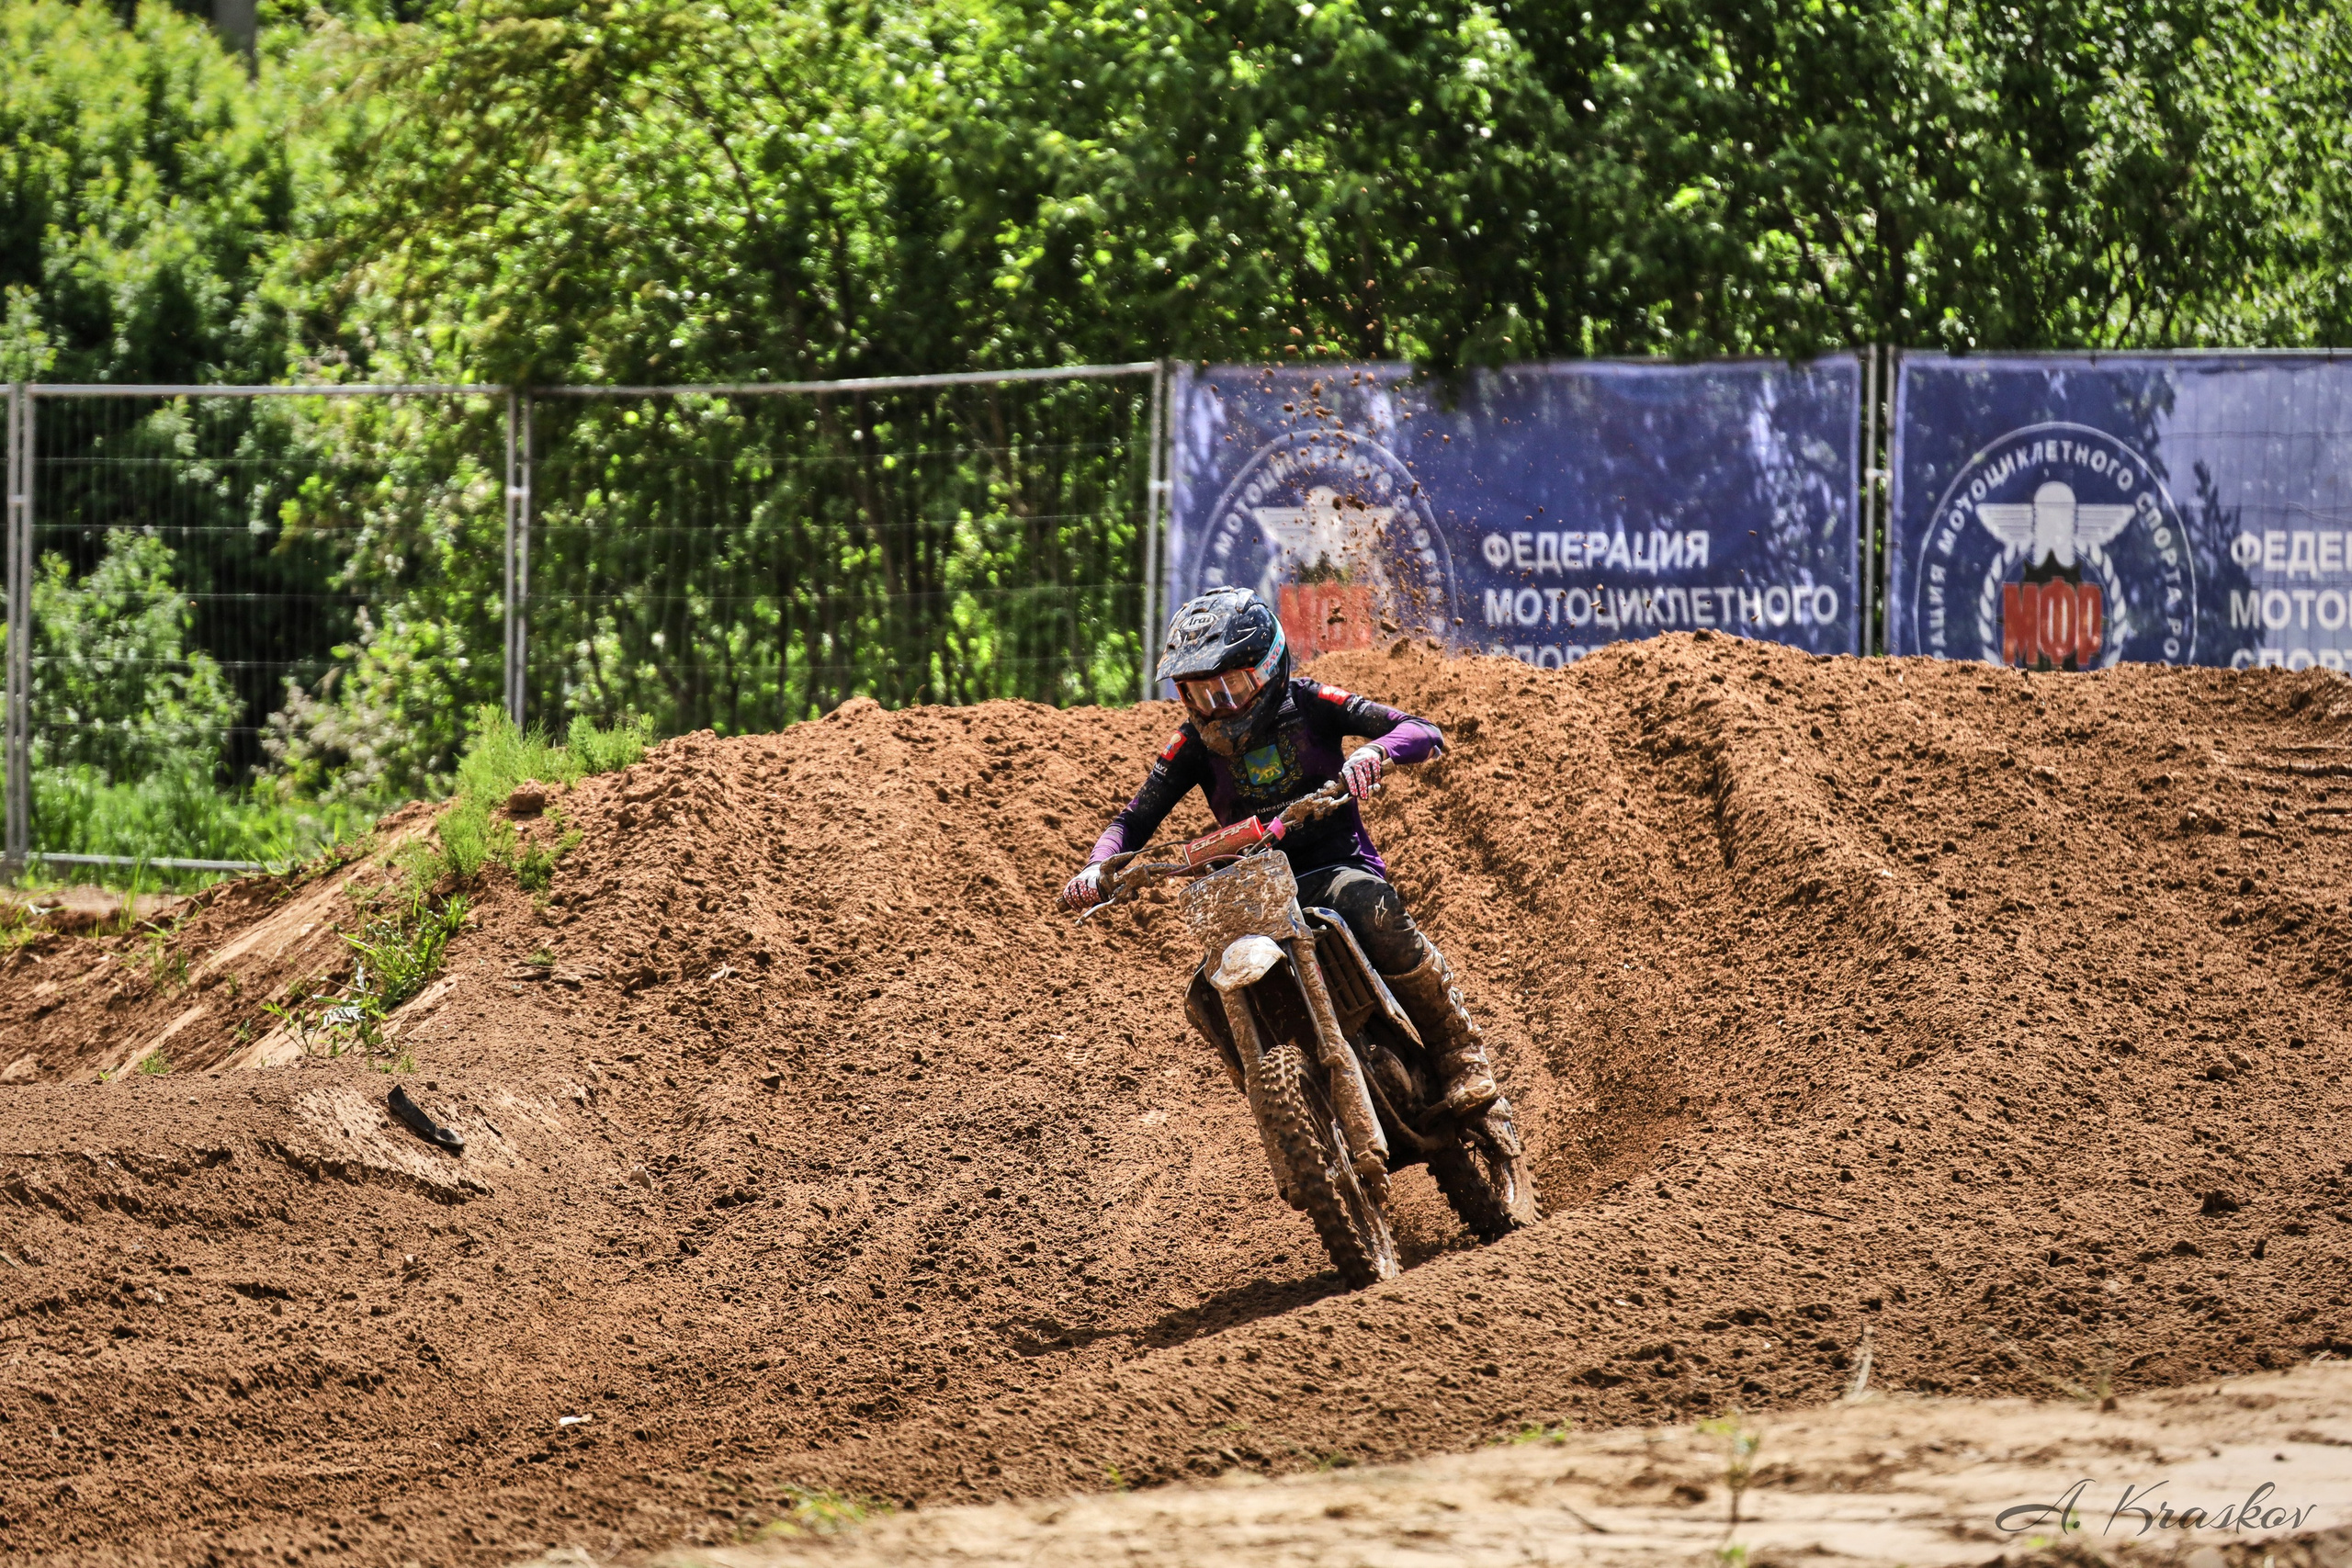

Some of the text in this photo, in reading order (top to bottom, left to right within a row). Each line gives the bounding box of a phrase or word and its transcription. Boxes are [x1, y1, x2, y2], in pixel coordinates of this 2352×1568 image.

[1483, 530, 1710, 574] ФЕДЕРАЦИЯ
[1938, 439, 2134, 556] МОТОЦИКЛЕТНОГО
[2135, 491, 2182, 604] СПОРТА
[2159, 617, 2183, 665] РО
[1483, 584, 1838, 630] МОТОЦИКЛЕТНОГО
[2230, 589, 2352, 630] МОТО
[1190, 819, 1251, 853] SCAR
